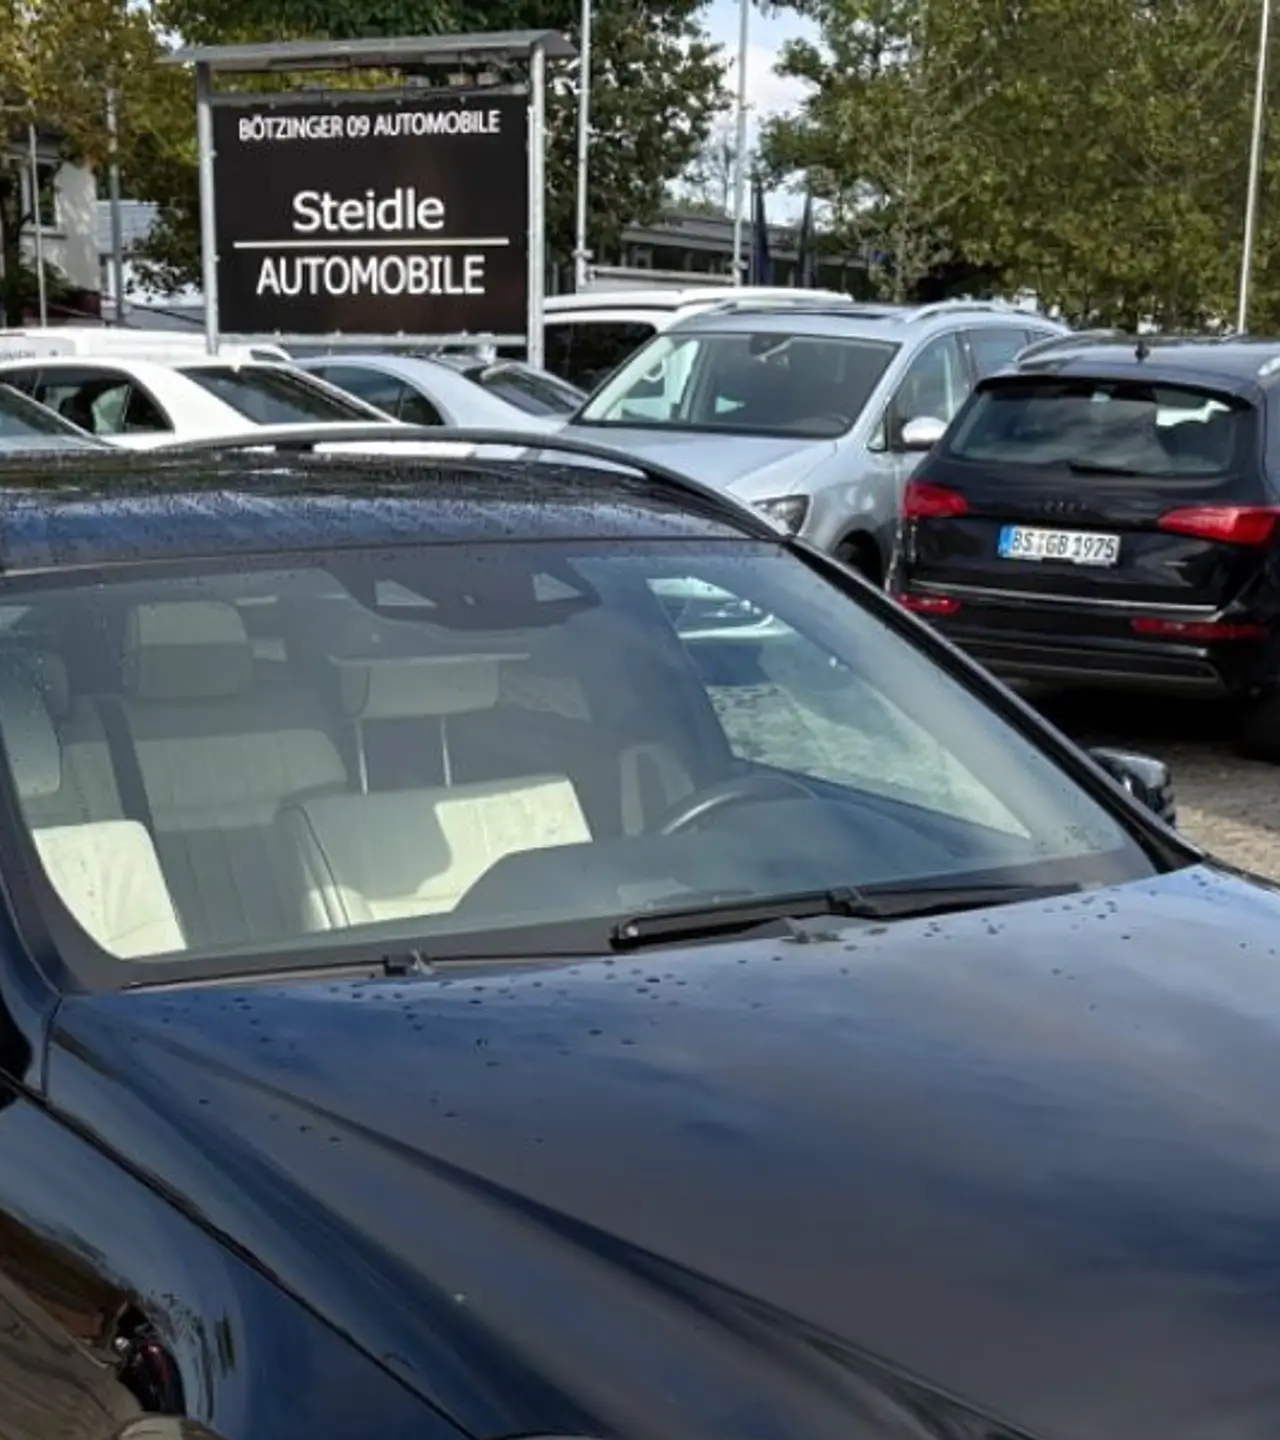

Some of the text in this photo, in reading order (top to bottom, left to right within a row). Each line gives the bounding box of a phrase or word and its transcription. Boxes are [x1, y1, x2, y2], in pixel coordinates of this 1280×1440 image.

[239, 110, 500, 141] BÖTZINGER 09 AUTOMOBILE
[292, 187, 444, 232] Steidle
[256, 254, 485, 296] AUTOMOBILE
[1072, 535, 1116, 558] 1975
